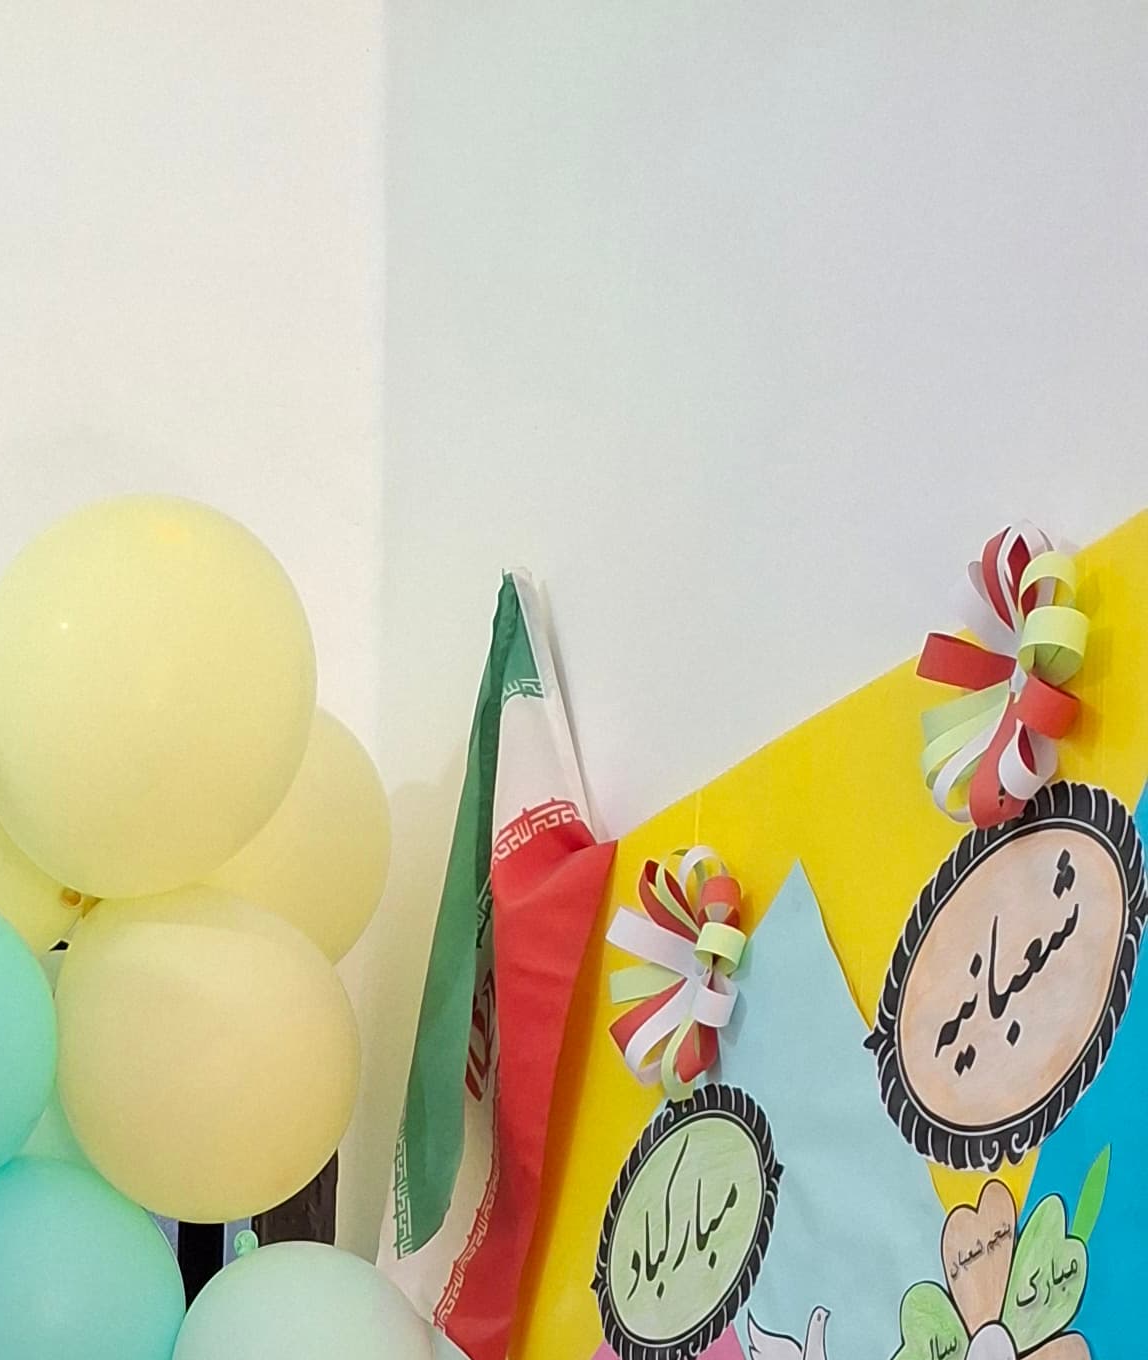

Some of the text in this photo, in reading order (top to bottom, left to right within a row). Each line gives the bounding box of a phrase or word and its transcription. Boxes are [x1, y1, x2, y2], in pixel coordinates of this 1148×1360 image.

[933, 847, 1081, 1077] شعبانیه
[626, 1131, 739, 1302] مبارکباد
[950, 1221, 1012, 1279] پنجم شعبان
[1016, 1256, 1078, 1308] مبارک
